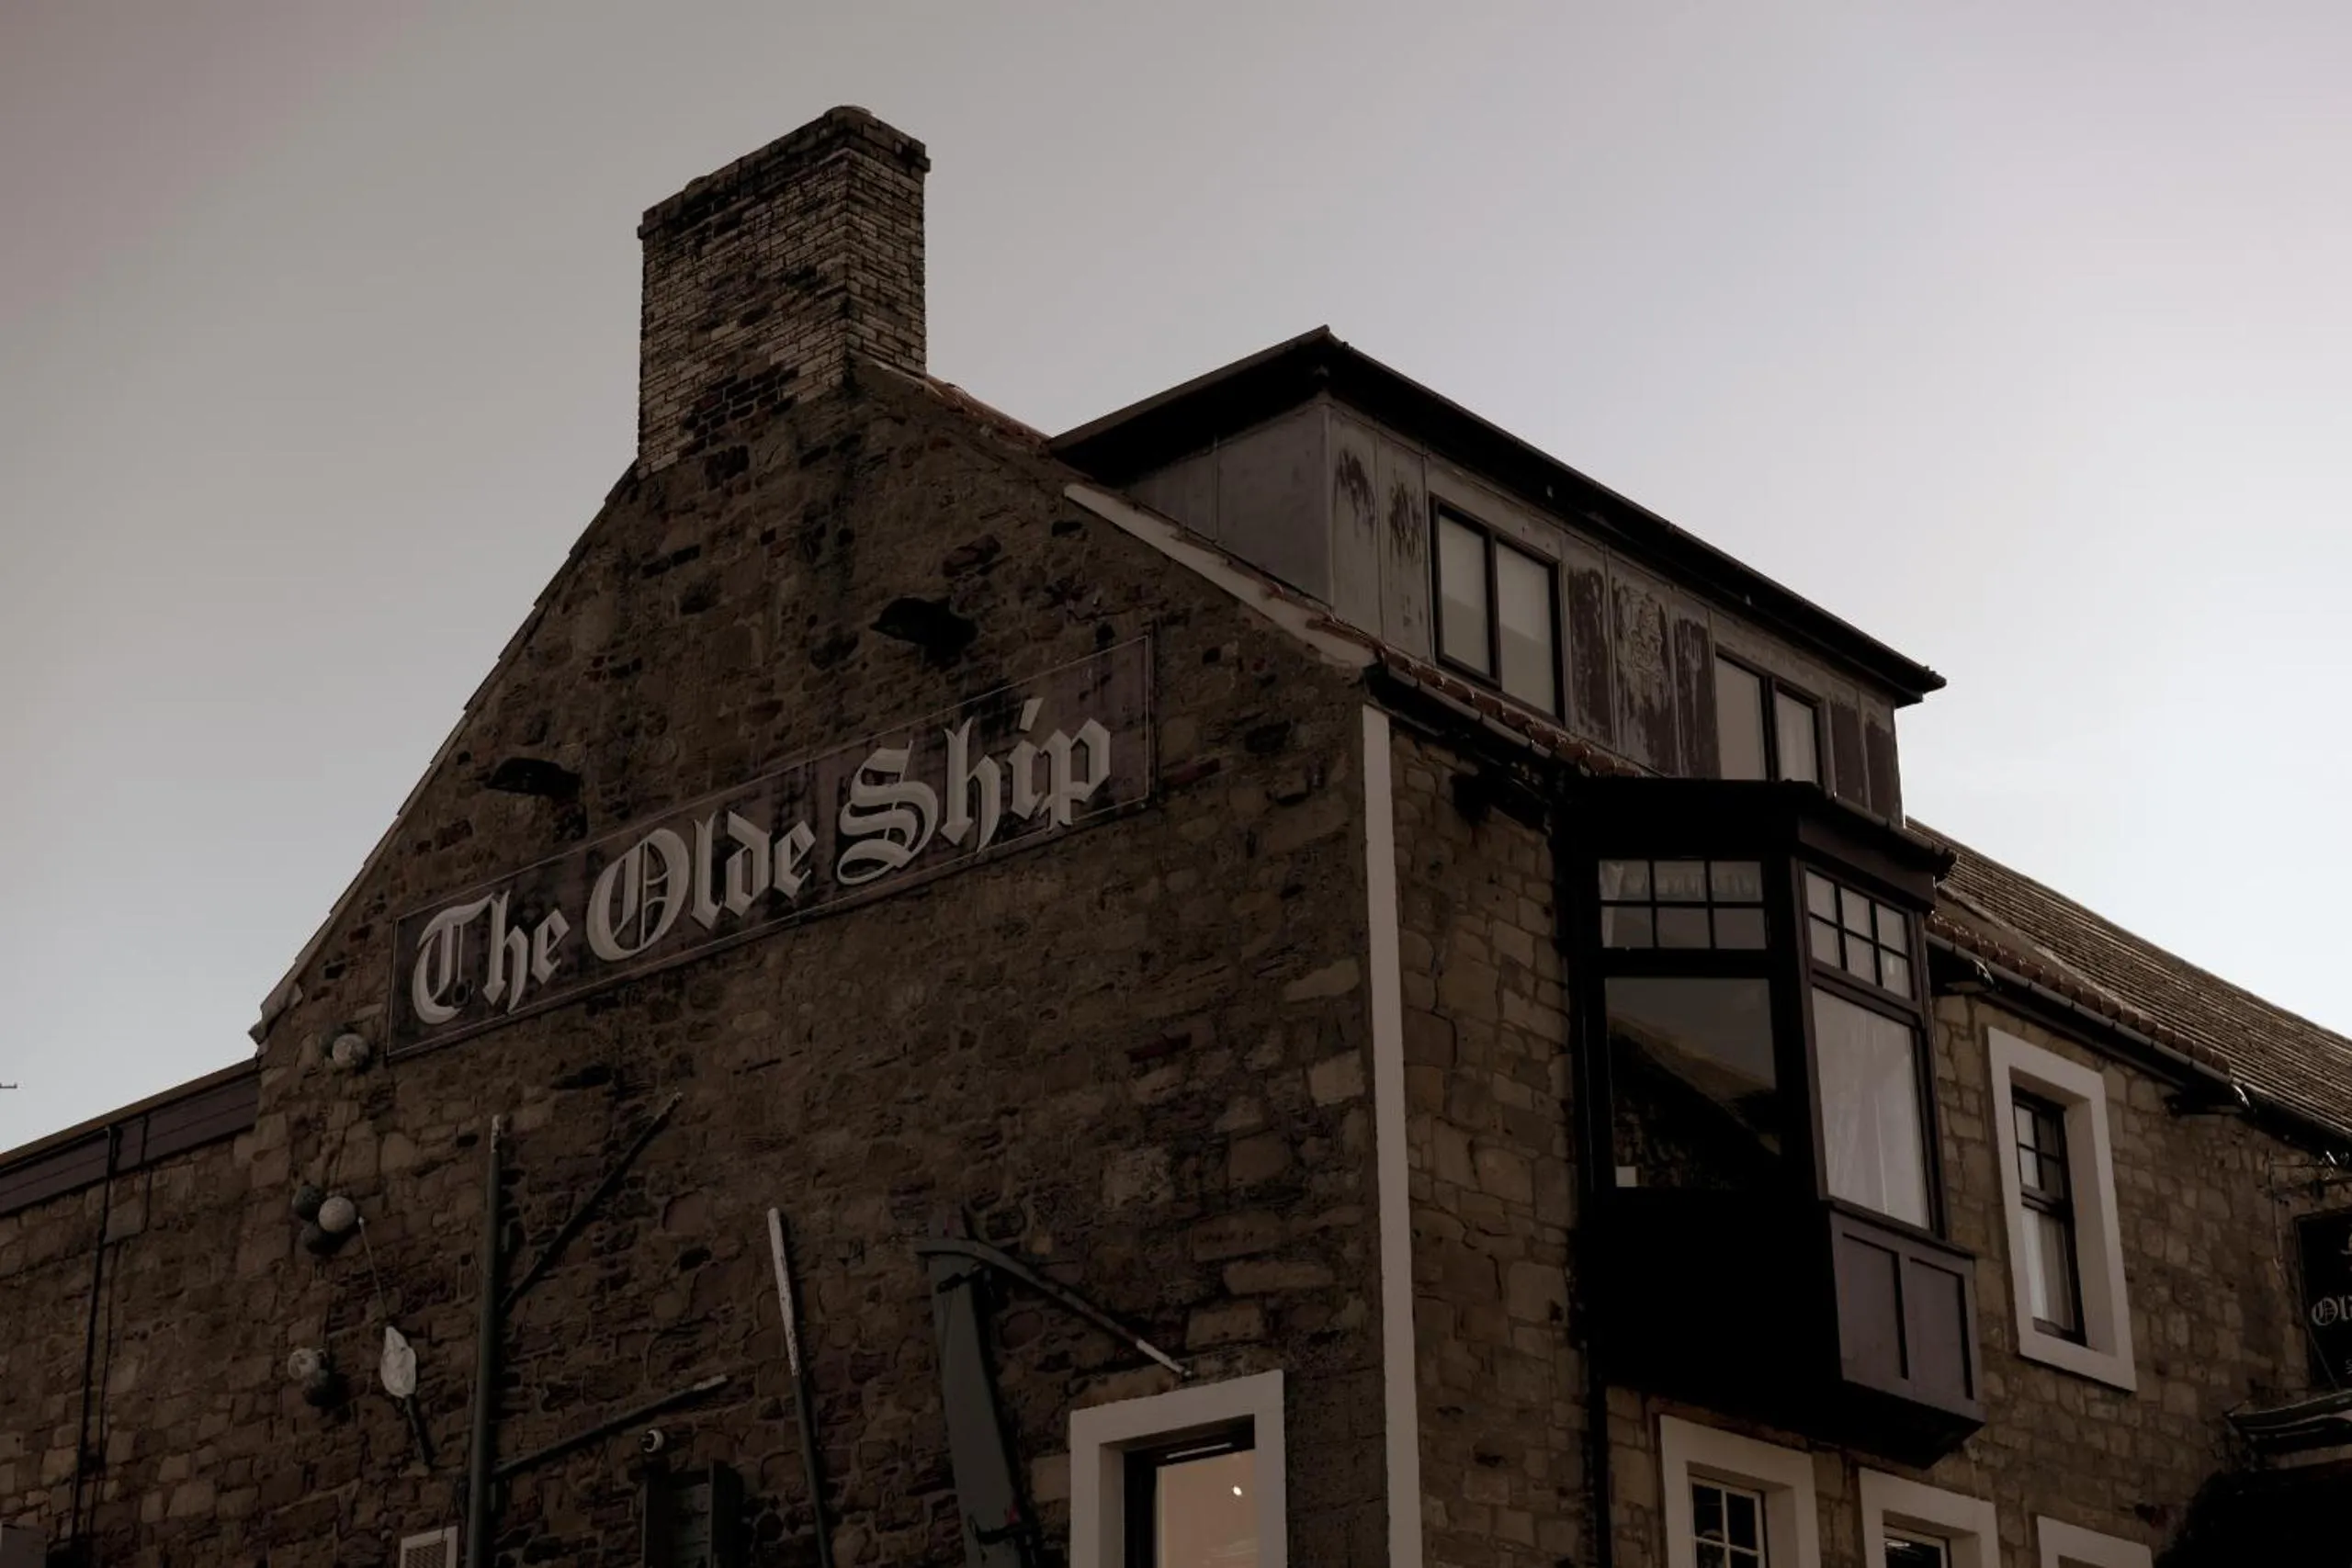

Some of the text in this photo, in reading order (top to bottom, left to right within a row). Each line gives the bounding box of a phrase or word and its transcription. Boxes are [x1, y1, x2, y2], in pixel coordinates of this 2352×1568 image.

[412, 697, 1112, 1025] The Olde Ship
